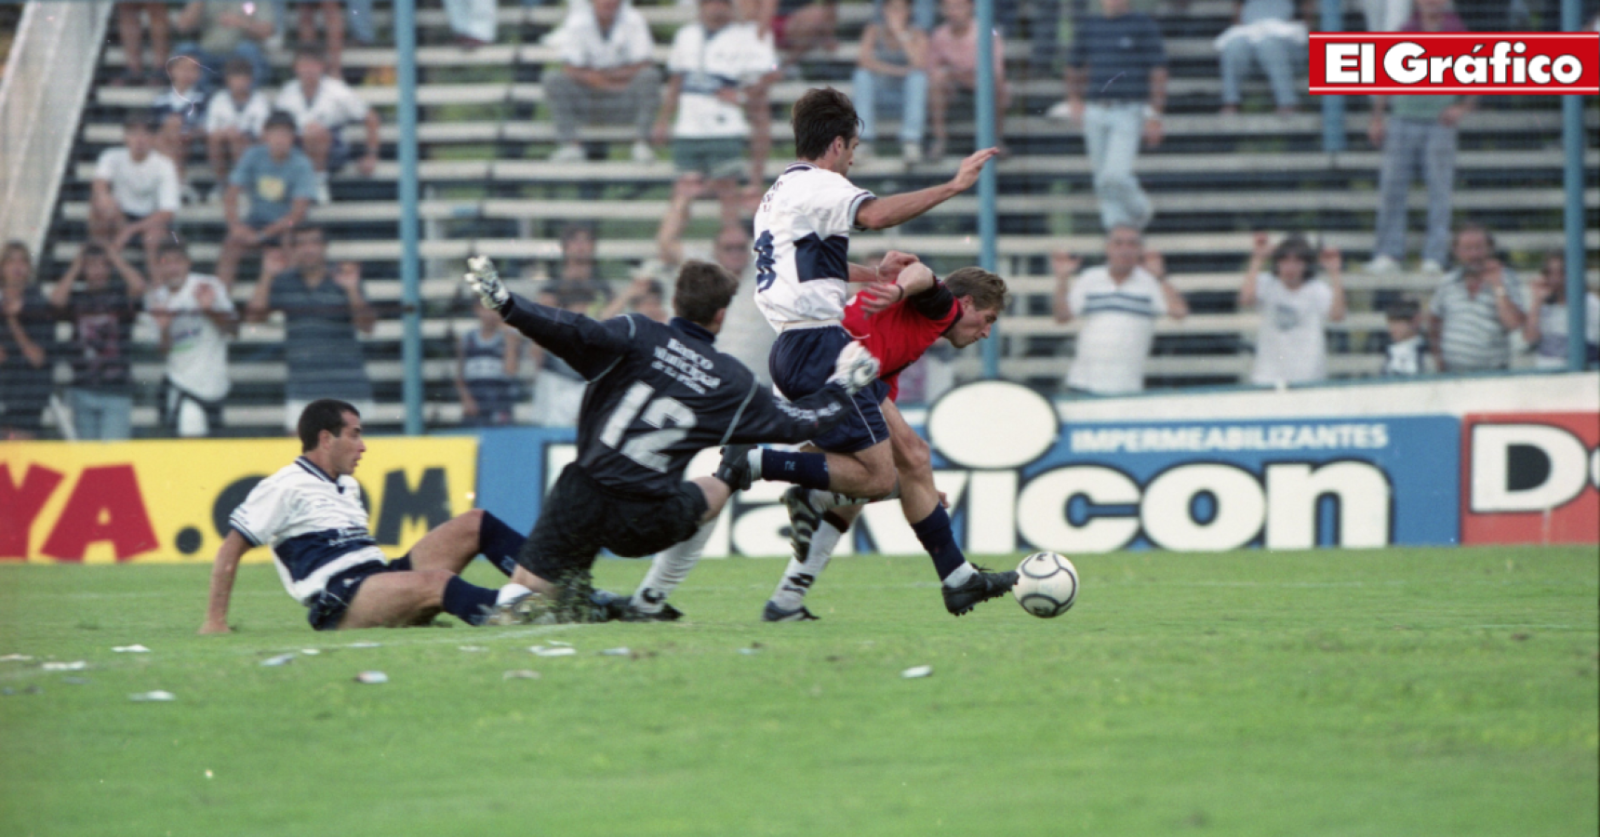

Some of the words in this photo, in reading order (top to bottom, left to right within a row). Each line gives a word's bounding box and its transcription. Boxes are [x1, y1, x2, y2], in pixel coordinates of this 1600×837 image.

[543, 380, 1394, 557] lavicon
[599, 380, 697, 474] 12
[1070, 423, 1389, 452] IMPERMEABILIZANTES
[0, 461, 453, 561] YA.M
